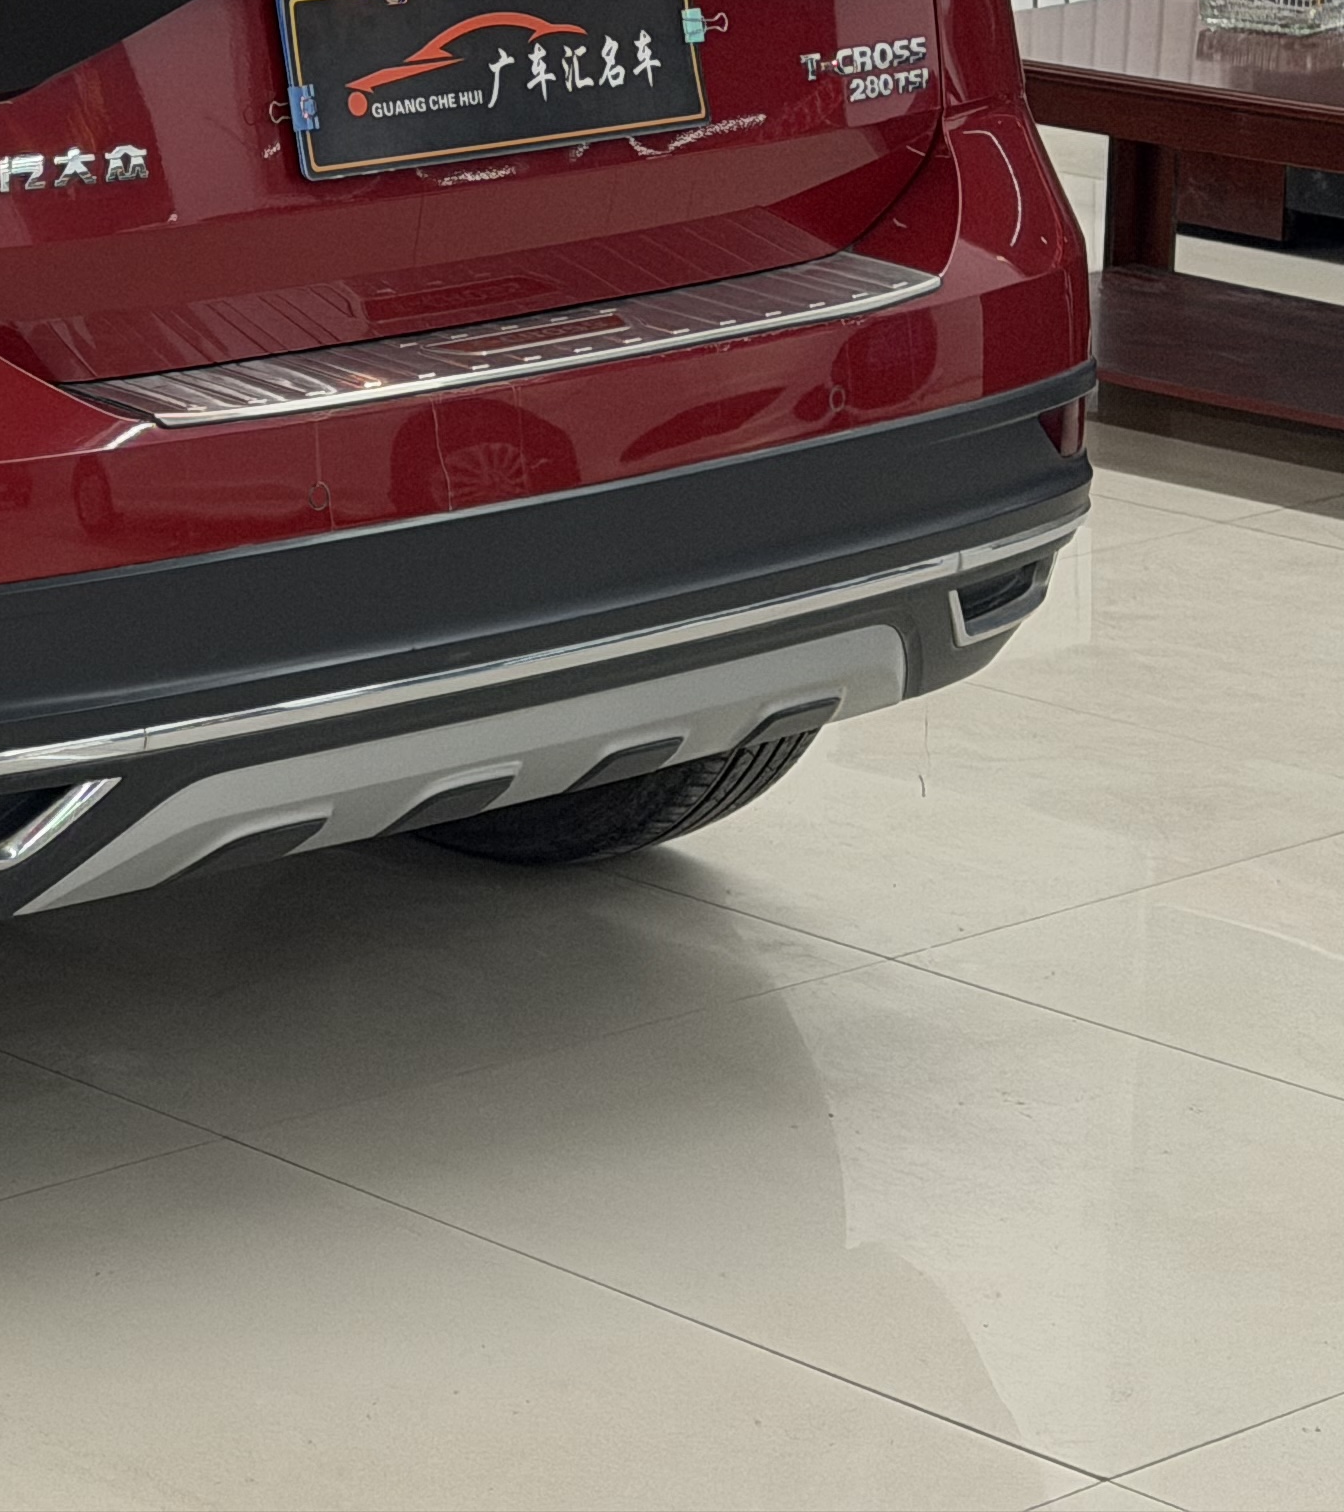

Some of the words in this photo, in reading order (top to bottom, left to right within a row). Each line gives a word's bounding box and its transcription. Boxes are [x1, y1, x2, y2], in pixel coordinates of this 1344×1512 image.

[487, 29, 662, 109] 广车汇名车
[800, 36, 927, 82] T-CROSS
[371, 97, 427, 118] GUANG
[429, 92, 457, 110] CHE
[459, 89, 483, 107] HUI
